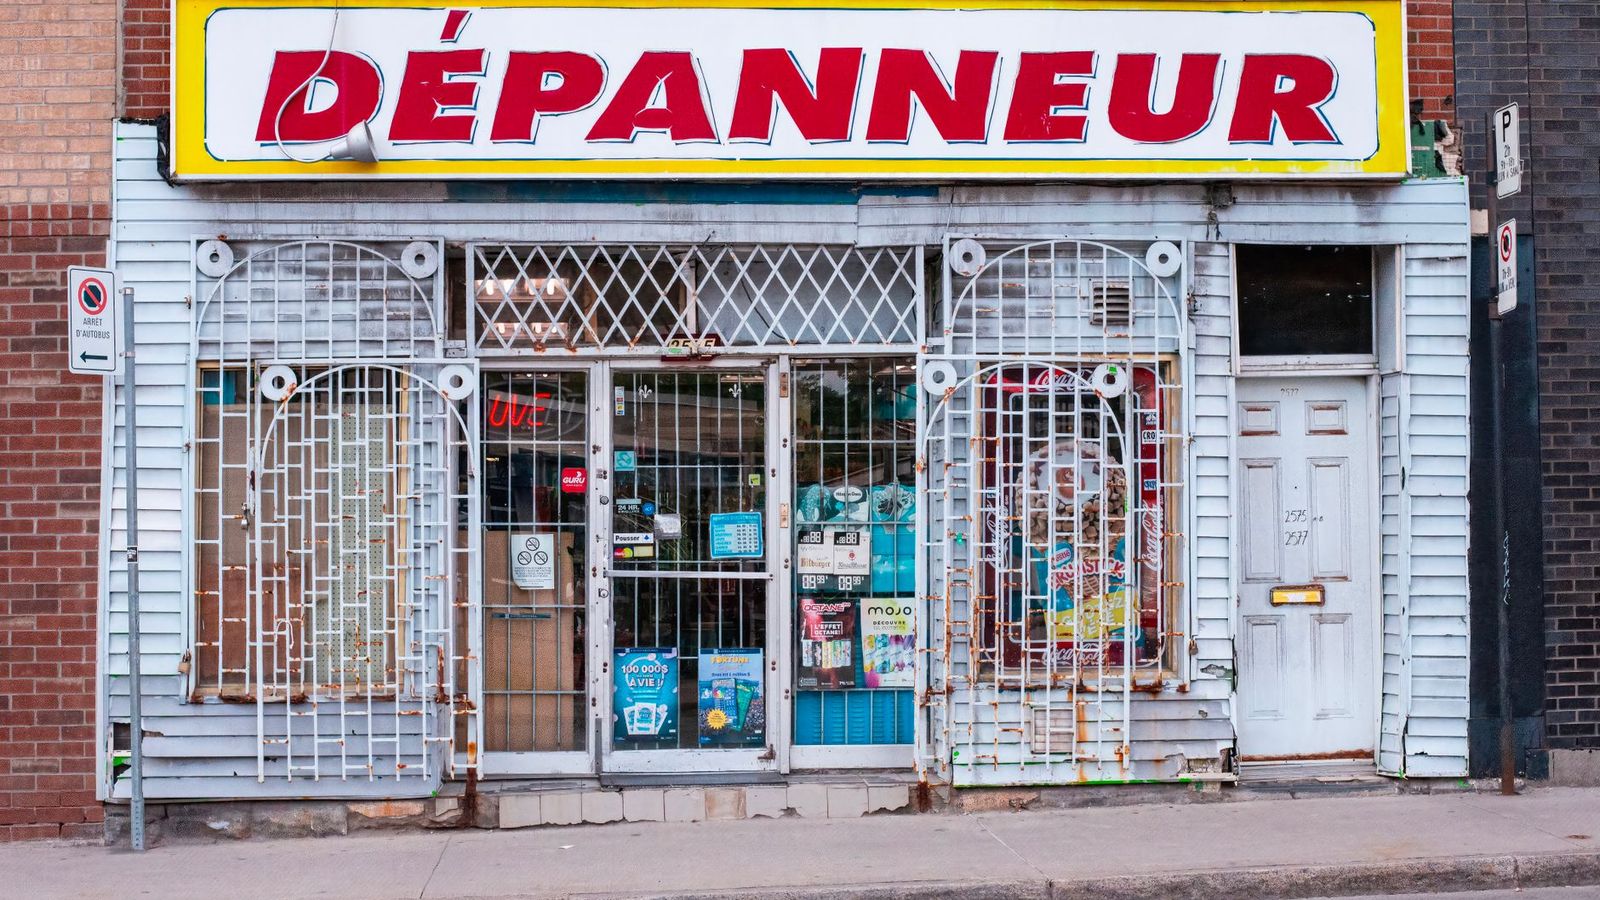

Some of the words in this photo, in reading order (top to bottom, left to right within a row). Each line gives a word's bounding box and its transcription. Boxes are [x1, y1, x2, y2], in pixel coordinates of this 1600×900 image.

[255, 10, 1343, 145] DÉPANNEUR
[1502, 110, 1511, 142] P
[76, 329, 111, 339] D'AUTOBUS
[668, 339, 715, 350] 255
[563, 476, 586, 484] GURU
[1284, 509, 1308, 523] 2575
[1284, 530, 1309, 546] 2577
[1048, 558, 1125, 589] RUSTIK
[803, 603, 844, 613] OCTANE
[621, 665, 640, 674] 100
[641, 664, 669, 675] 000$
[638, 678, 655, 687] VIE
